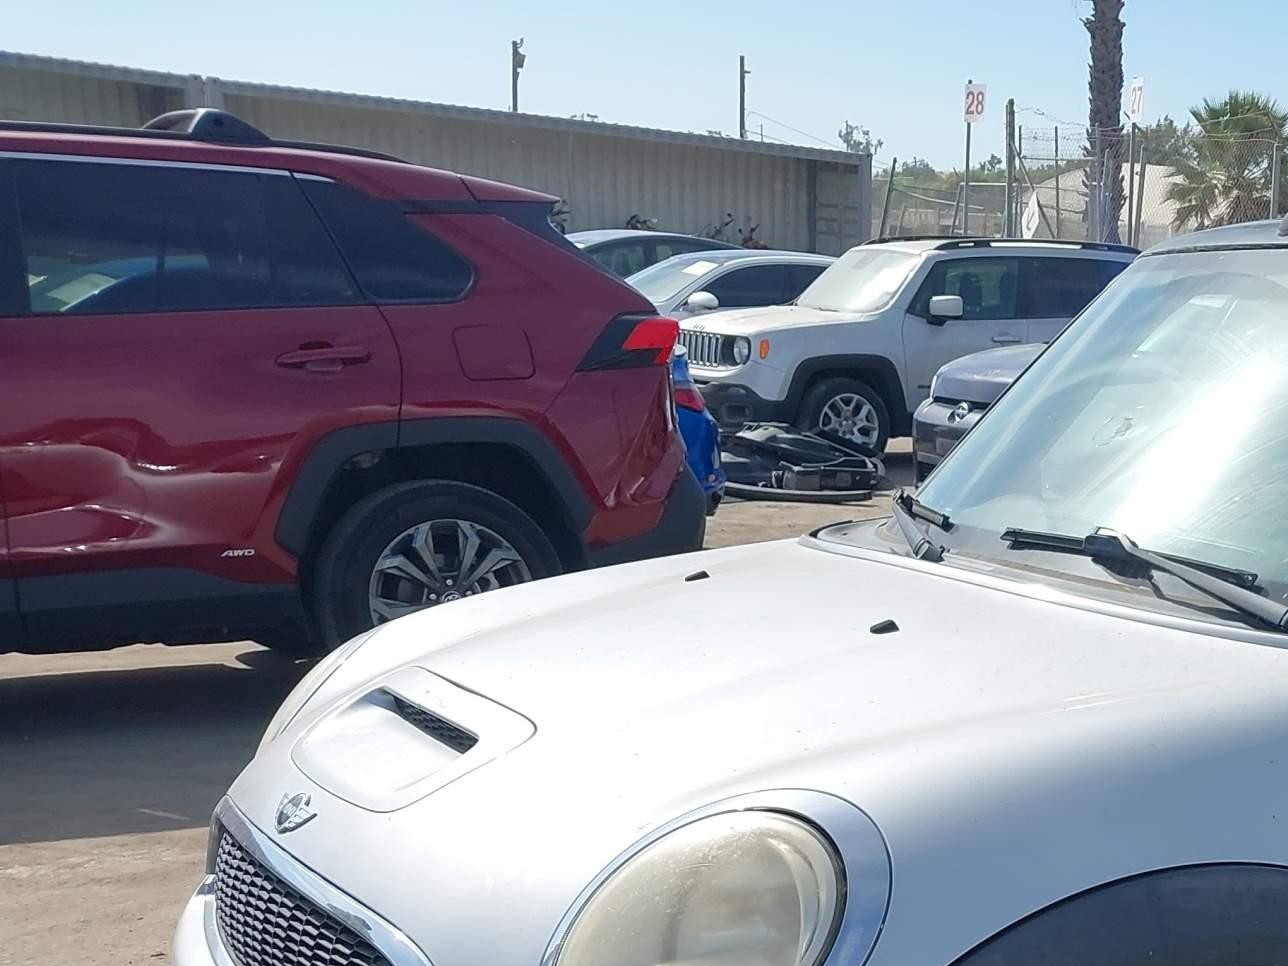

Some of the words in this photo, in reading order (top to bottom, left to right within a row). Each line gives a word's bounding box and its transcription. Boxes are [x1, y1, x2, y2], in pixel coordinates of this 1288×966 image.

[965, 90, 985, 115] 28
[1131, 86, 1143, 114] 27
[220, 549, 256, 557] AWD
